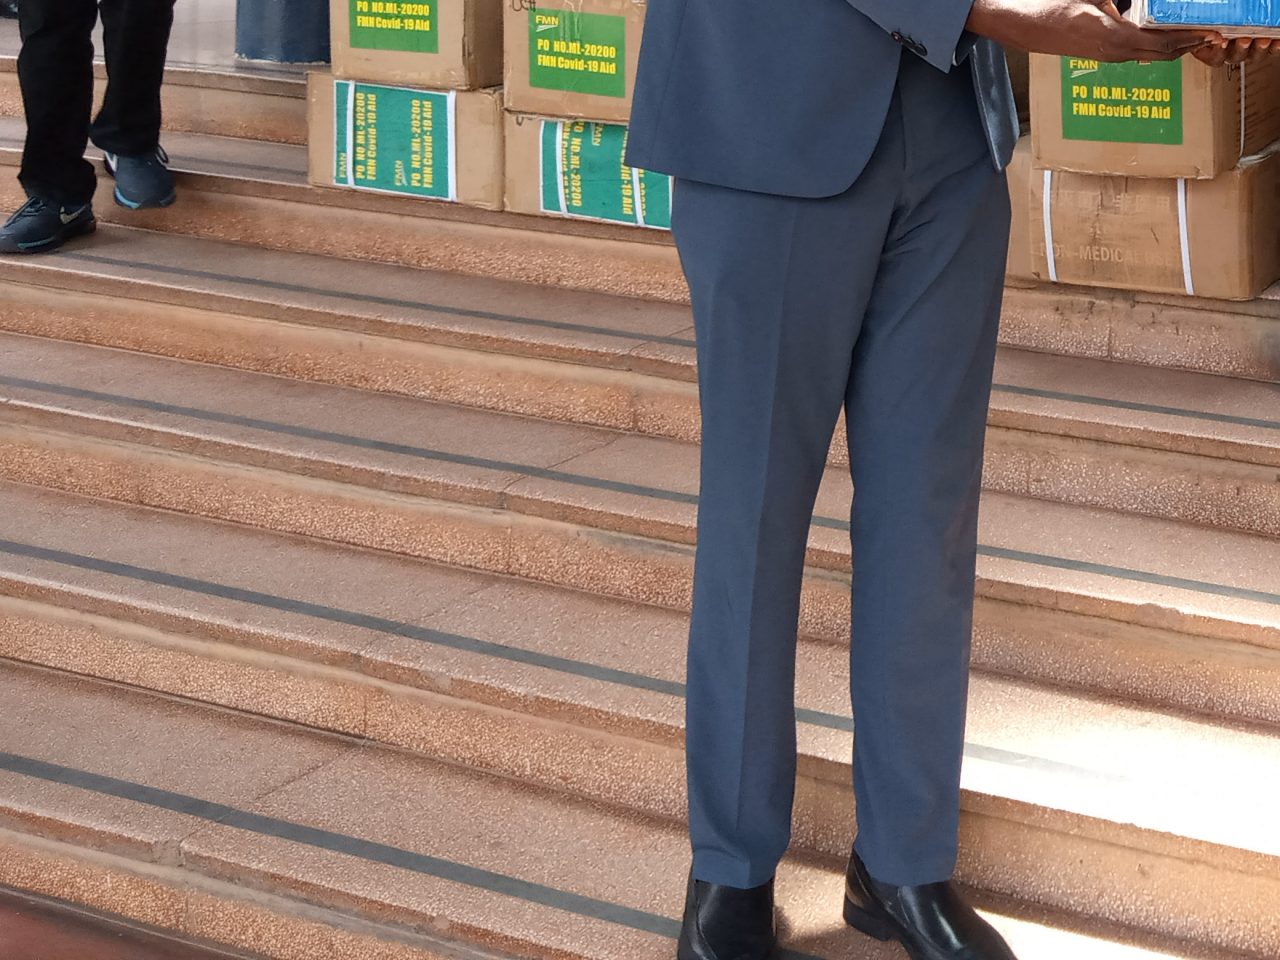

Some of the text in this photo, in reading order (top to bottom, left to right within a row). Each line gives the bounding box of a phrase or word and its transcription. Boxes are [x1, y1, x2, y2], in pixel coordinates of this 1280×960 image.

[356, 1, 369, 12] PO
[356, 16, 430, 31] FMN Covid-19 Aid
[535, 15, 559, 25] FMN
[537, 39, 550, 51] PO
[537, 54, 616, 75] FMN Covid-19 Aid
[1069, 60, 1098, 70] FMN
[1072, 85, 1171, 102] PO NO.ML-20200
[1072, 103, 1171, 120] FMN Covid-19 Aid
[367, 93, 377, 180] FMN Covid-19 Aid
[593, 123, 604, 146] MN
[423, 100, 433, 188] FMN Covid-19 Aid
[622, 196, 633, 215] Aid
